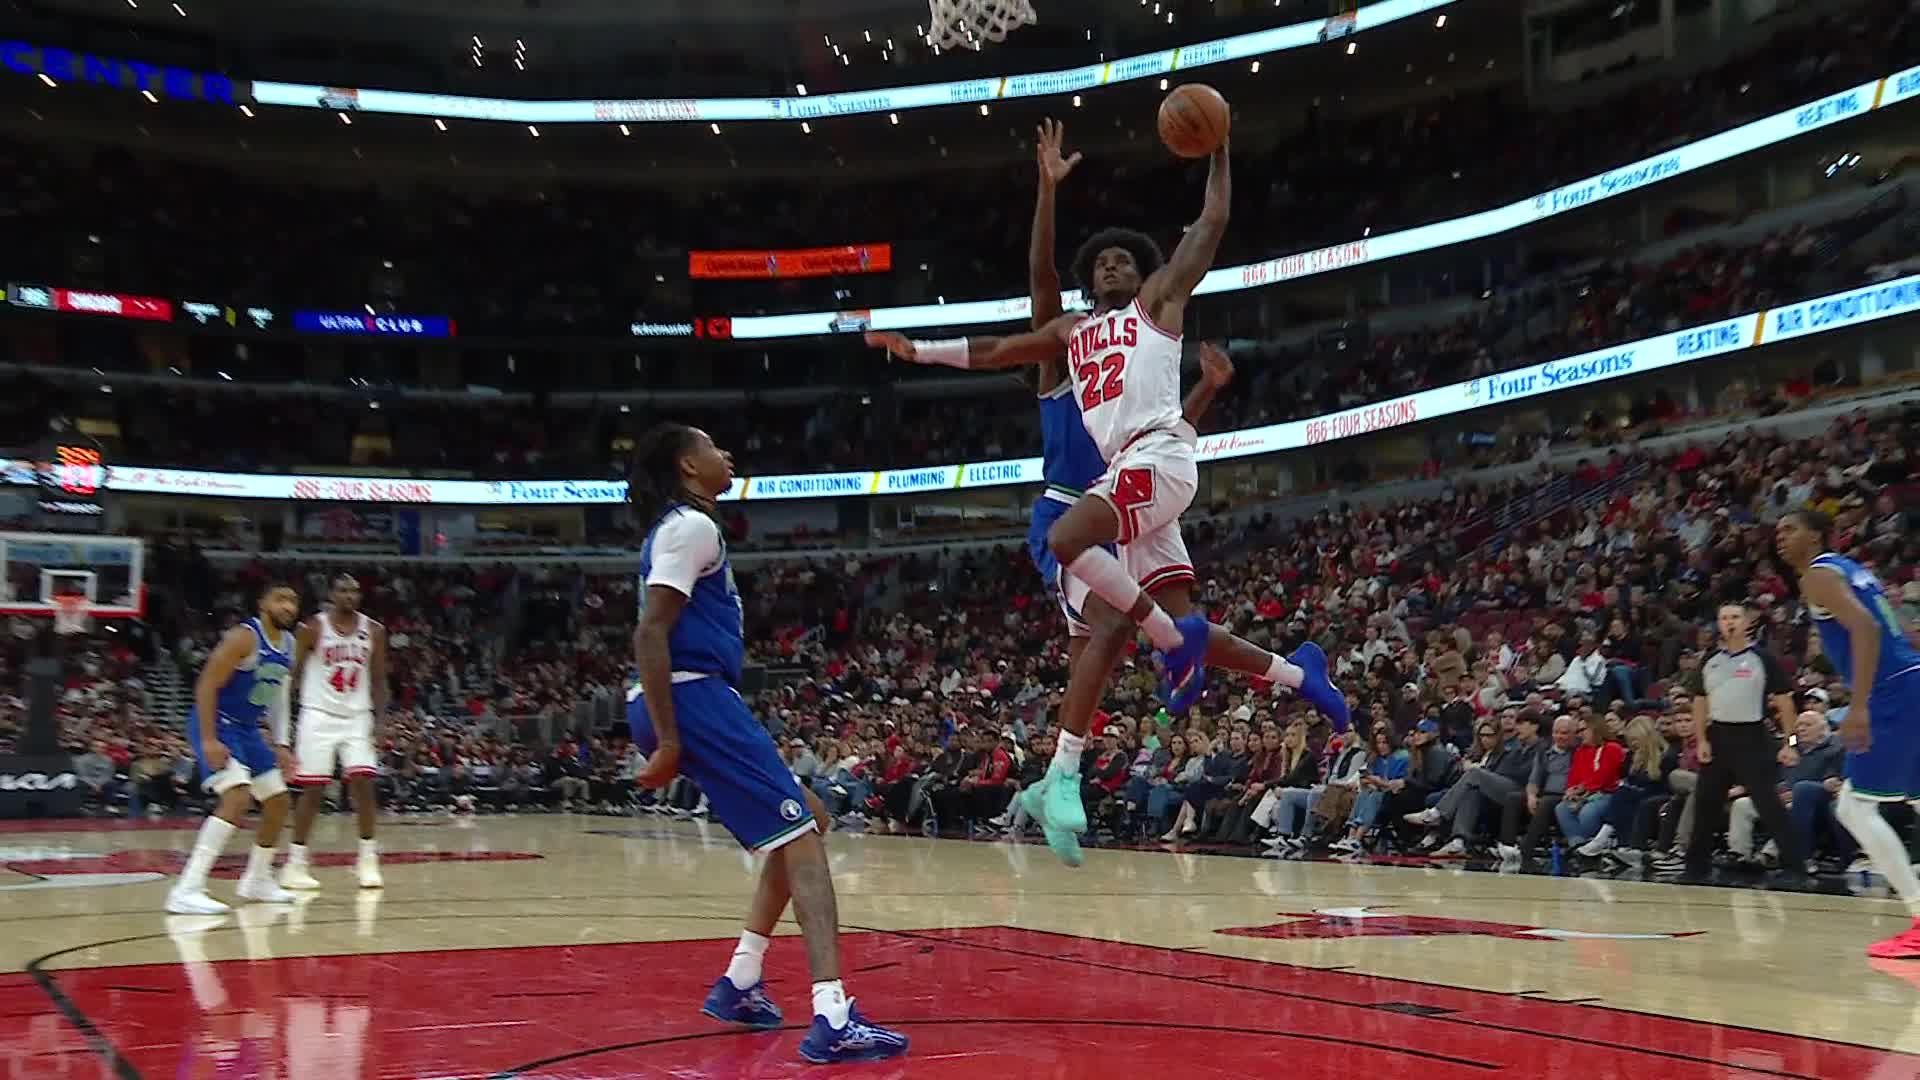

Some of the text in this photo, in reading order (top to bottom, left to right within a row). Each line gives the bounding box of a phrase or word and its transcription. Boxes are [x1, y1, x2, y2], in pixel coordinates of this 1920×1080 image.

[0, 39, 233, 105] CENTER
[1068, 317, 1138, 370] BULLS
[1676, 281, 1920, 356] HEATING AIR CONDITIONIN
[1079, 352, 1126, 412] 22
[1487, 351, 1637, 400] Four Seasons
[1363, 399, 1416, 433] SEASONS
[509, 481, 558, 500] Four
[757, 463, 1022, 493] AIR CONDITIONING PLUMBING ELECTRIC
